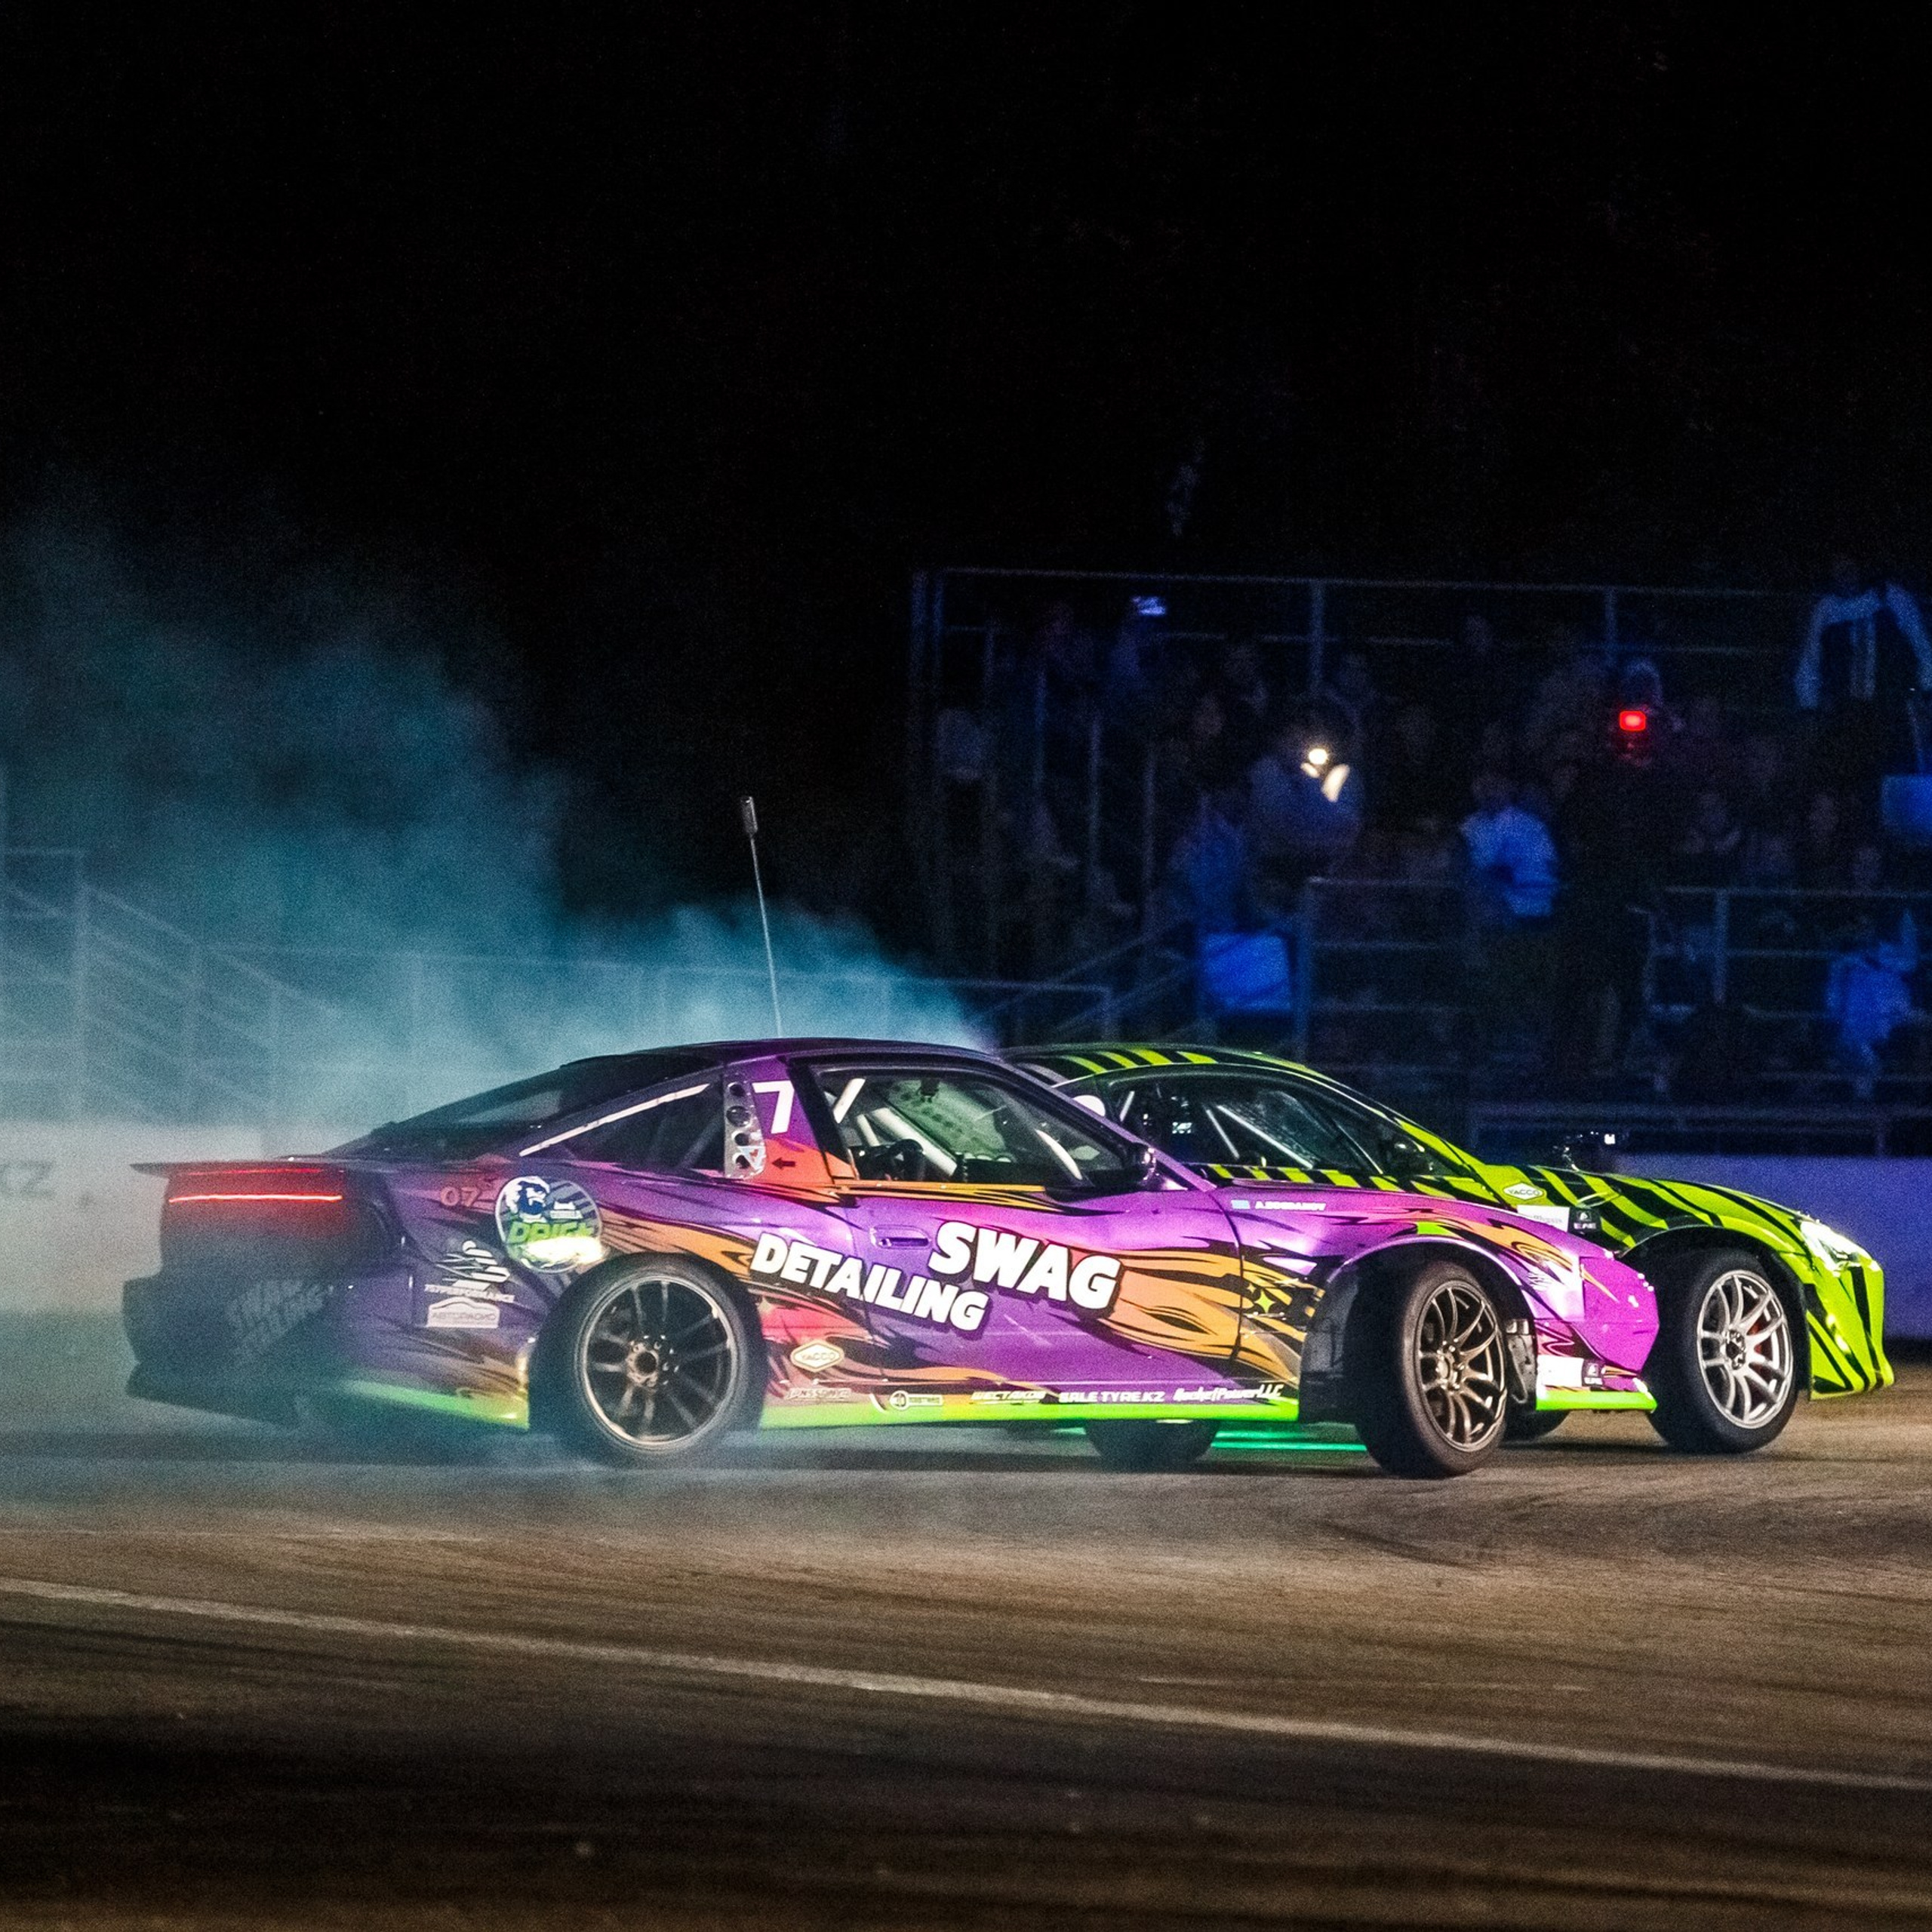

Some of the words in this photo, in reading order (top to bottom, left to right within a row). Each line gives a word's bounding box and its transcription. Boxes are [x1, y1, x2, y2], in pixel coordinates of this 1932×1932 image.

[752, 1081, 795, 1134] 7
[440, 1186, 479, 1207] 07
[749, 1232, 989, 1331] DETAILING
[928, 1221, 1121, 1309] SWAG
